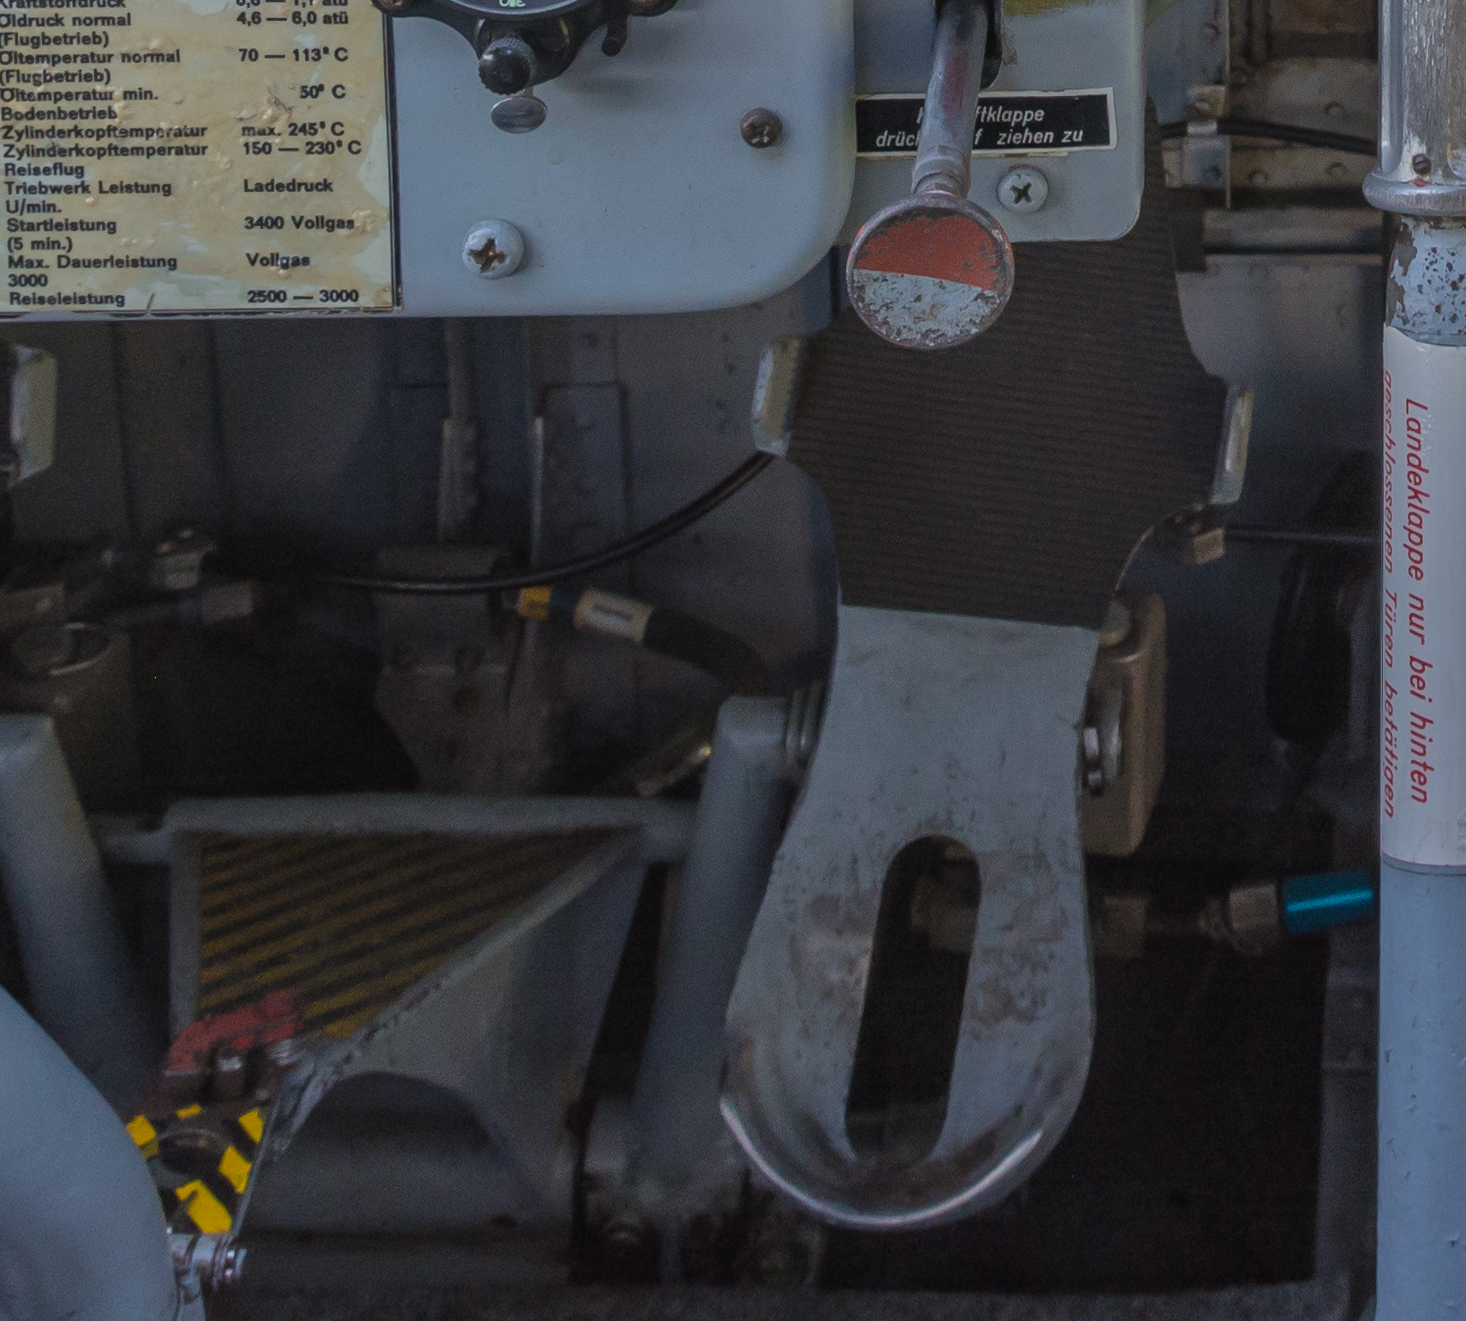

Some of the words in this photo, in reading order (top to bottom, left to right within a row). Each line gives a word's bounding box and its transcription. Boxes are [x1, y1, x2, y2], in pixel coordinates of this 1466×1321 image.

[71, 13, 132, 26] normal
[4, 163, 85, 178] Reiseflug
[4, 181, 91, 194] Triebwerk
[98, 181, 172, 196] Leistung
[243, 179, 333, 193] Ladedruck
